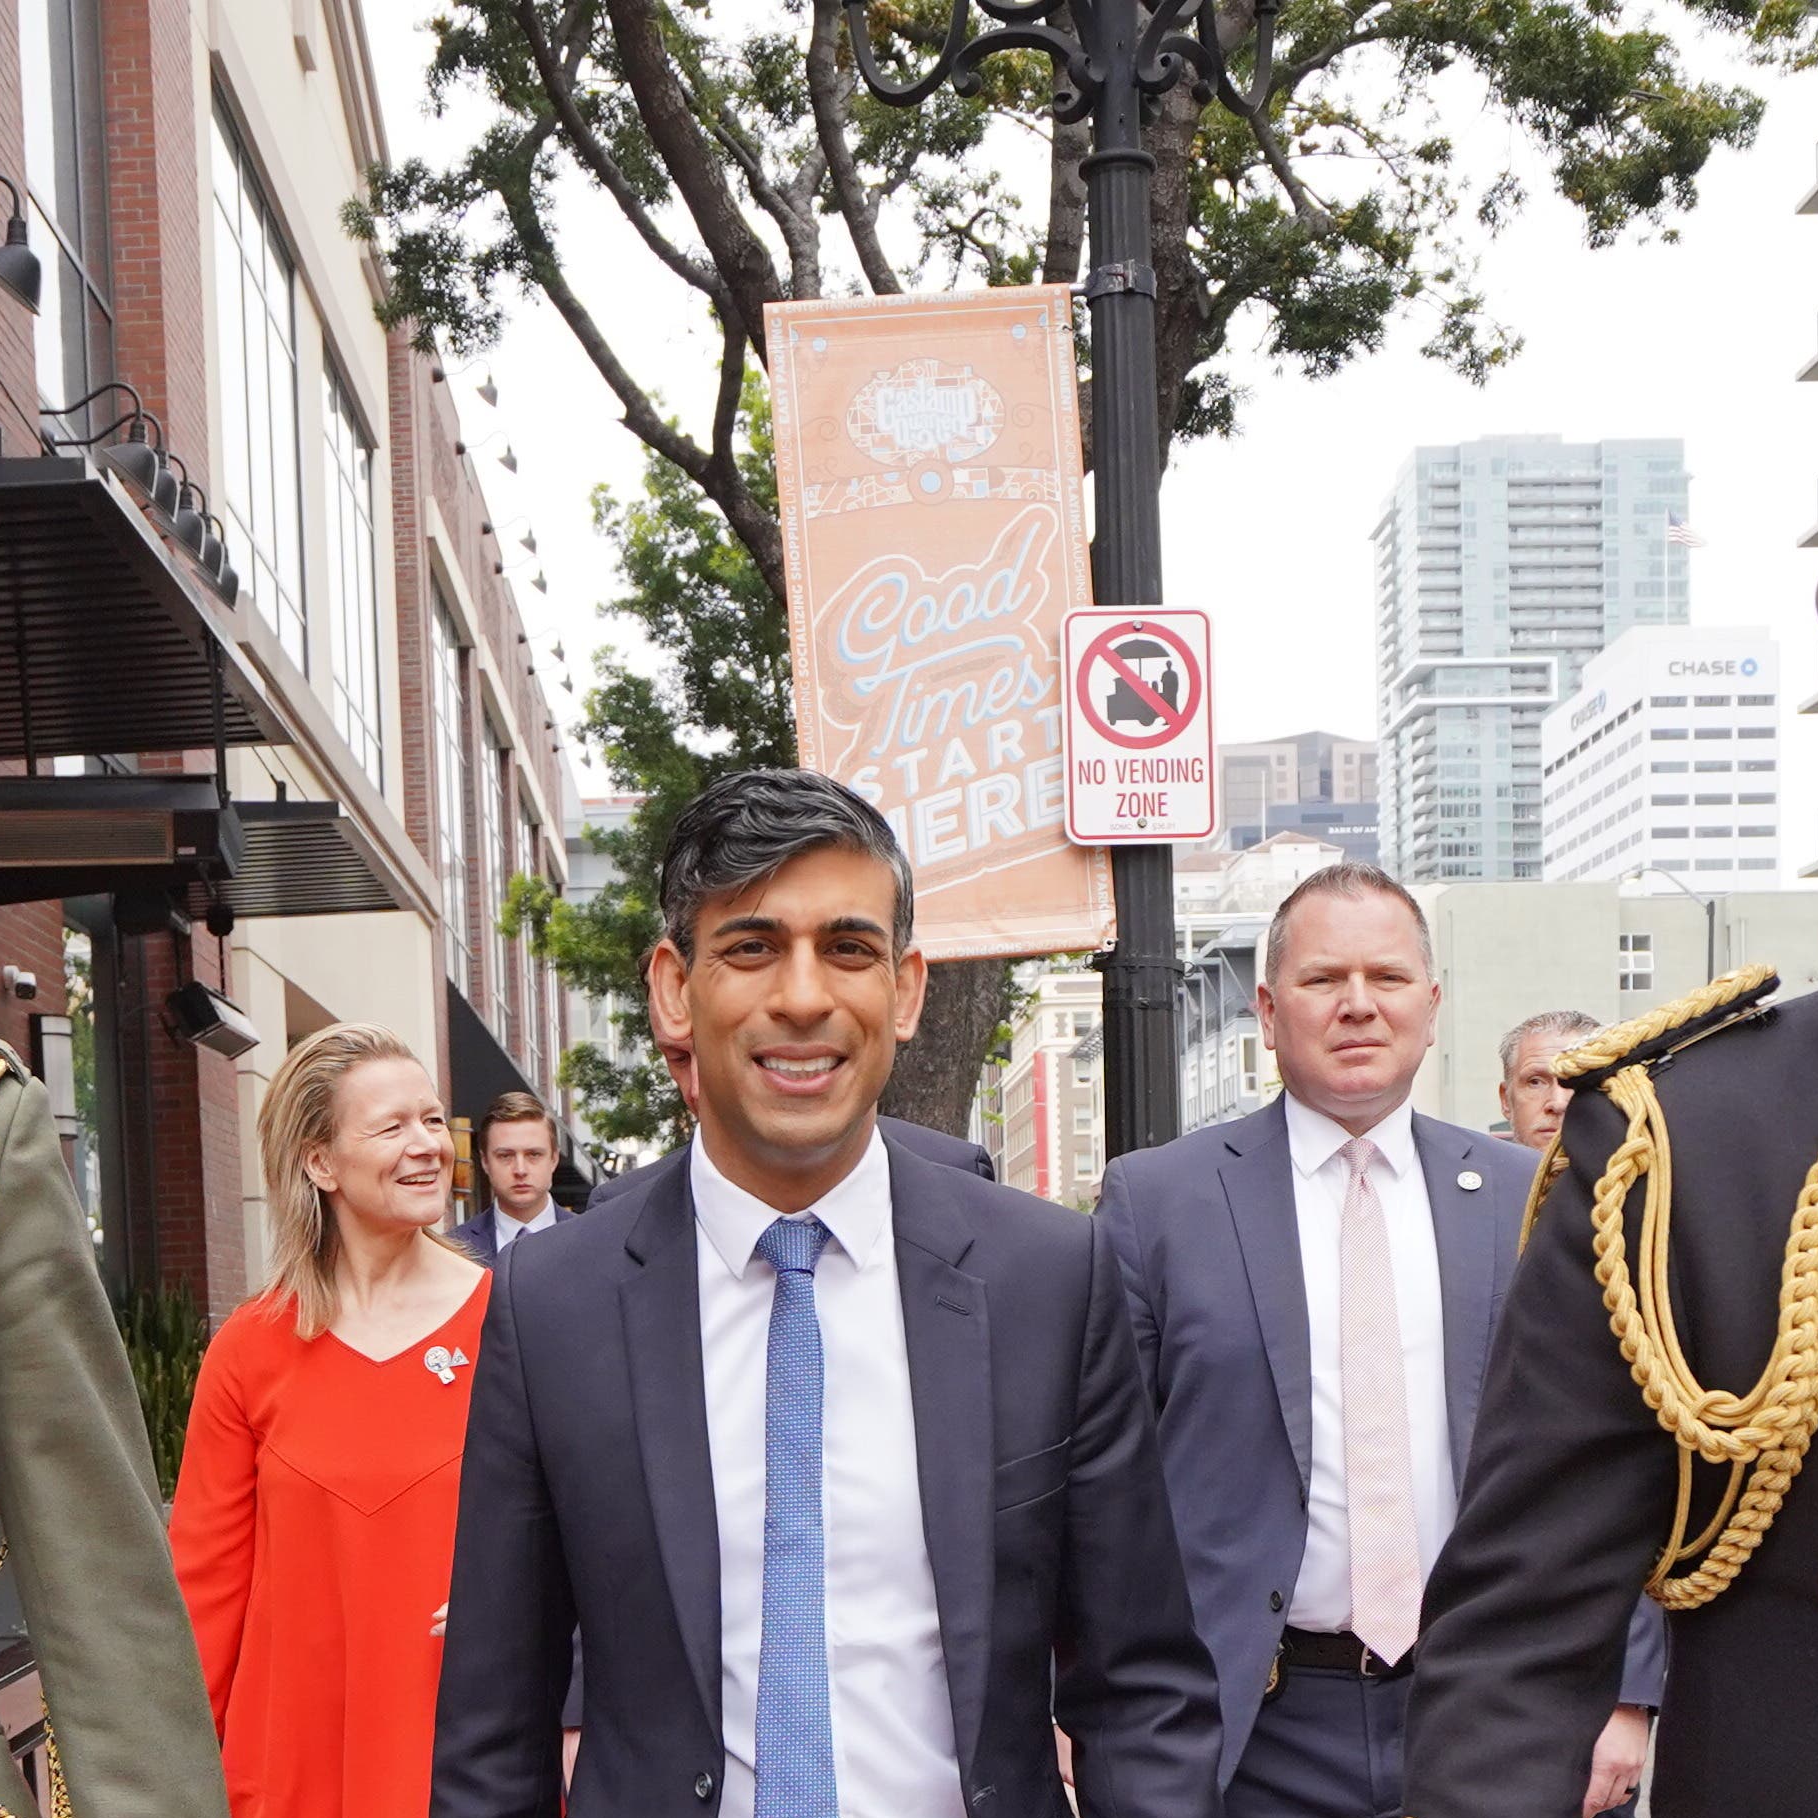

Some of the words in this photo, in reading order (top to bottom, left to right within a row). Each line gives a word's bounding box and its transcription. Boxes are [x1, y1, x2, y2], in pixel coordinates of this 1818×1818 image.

[785, 299, 882, 314] ENTERTAINMENT
[885, 296, 915, 307] EASY
[921, 291, 974, 305] PARKING
[771, 318, 787, 383] PARKING
[776, 387, 791, 425] EASY
[779, 426, 794, 471] MUSIC
[1062, 416, 1077, 475] DANCING
[783, 476, 796, 505] LIVE
[1067, 476, 1082, 532] PLAYING
[785, 506, 803, 582] SHOPPING
[1072, 534, 1087, 600] LAUGHING
[792, 584, 809, 677] SOCIALIZING
[837, 521, 1041, 690] Good
[853, 634, 1056, 758] Times
[1668, 660, 1736, 676] CHASE
[799, 681, 815, 752] LAUGHING
[848, 703, 1062, 806] START
[1078, 759, 1106, 785] NO
[1115, 757, 1204, 784] VENDING
[1116, 792, 1169, 818] ZONE
[1328, 826, 1351, 834] BANK
[1352, 826, 1363, 834] OF
[957, 941, 1022, 956] SHOPPING
